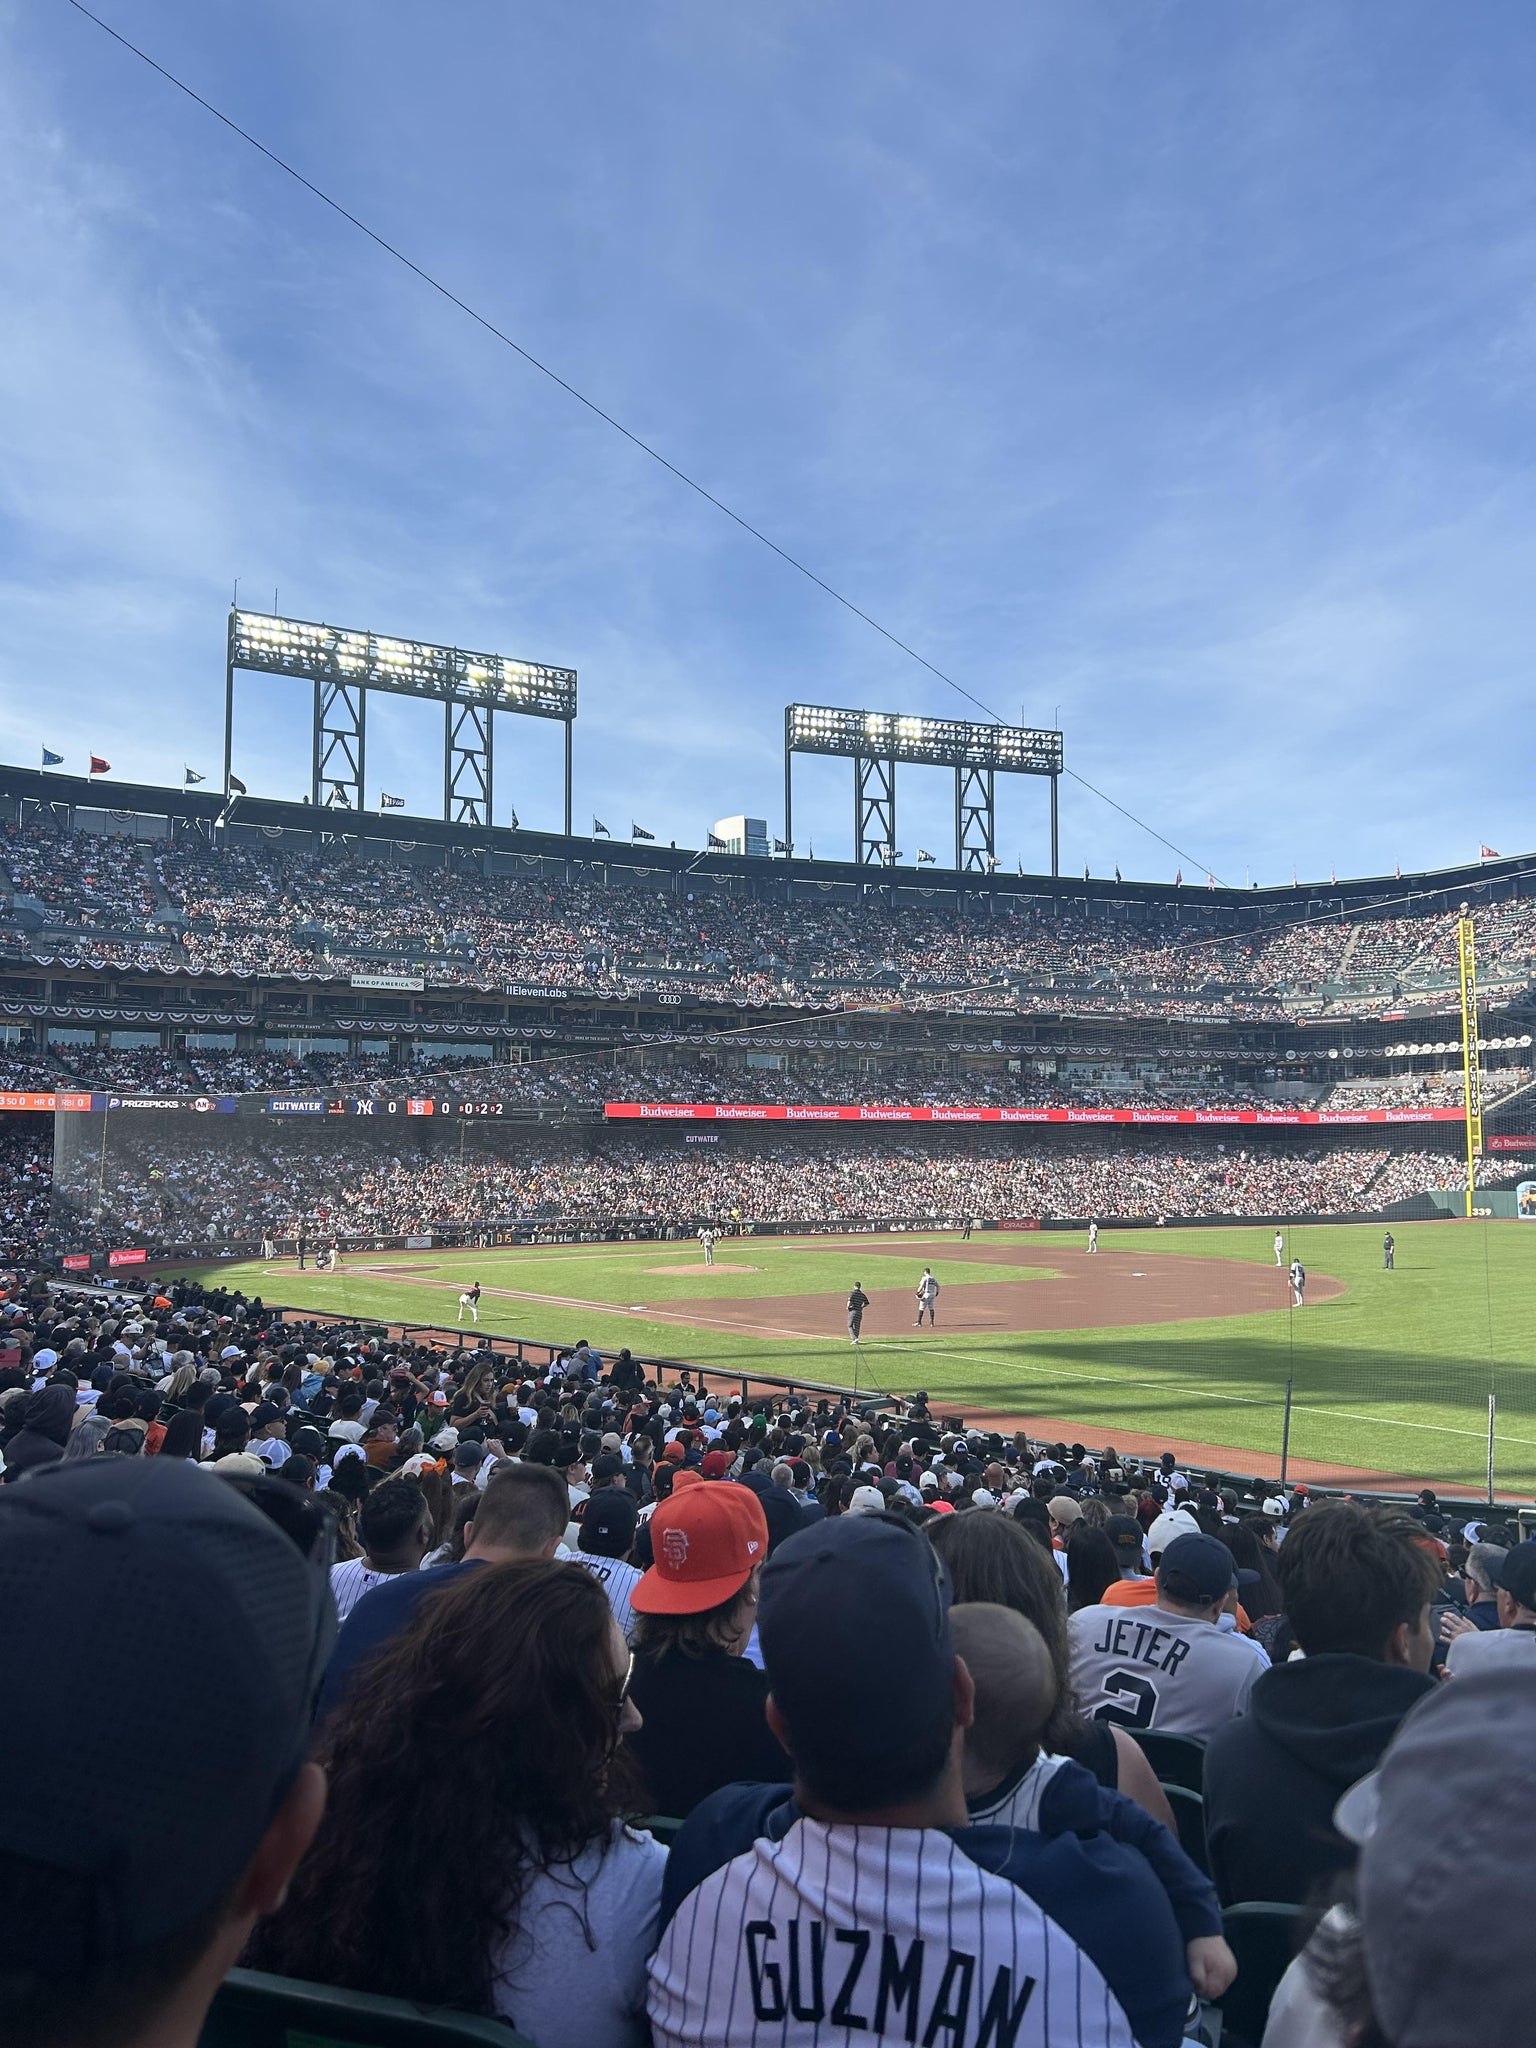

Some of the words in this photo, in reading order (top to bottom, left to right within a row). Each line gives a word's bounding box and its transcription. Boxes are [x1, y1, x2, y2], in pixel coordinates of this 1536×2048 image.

[20, 1097, 25, 1105] 0
[48, 1098, 55, 1106] 0
[77, 1099, 84, 1107] 0
[121, 1100, 179, 1108] PRIZEPICKS
[273, 1101, 321, 1111] CUTWATER
[338, 1100, 342, 1108] 1
[356, 1100, 373, 1114] NY
[388, 1102, 396, 1113] 0
[442, 1103, 450, 1113] 0
[465, 1103, 473, 1114] 0
[480, 1104, 487, 1114] 2
[495, 1104, 502, 1114] 2
[1094, 1619, 1190, 1676] JETER
[1093, 1667, 1159, 1729] 2
[746, 1919, 1036, 2048] GUZMAN
